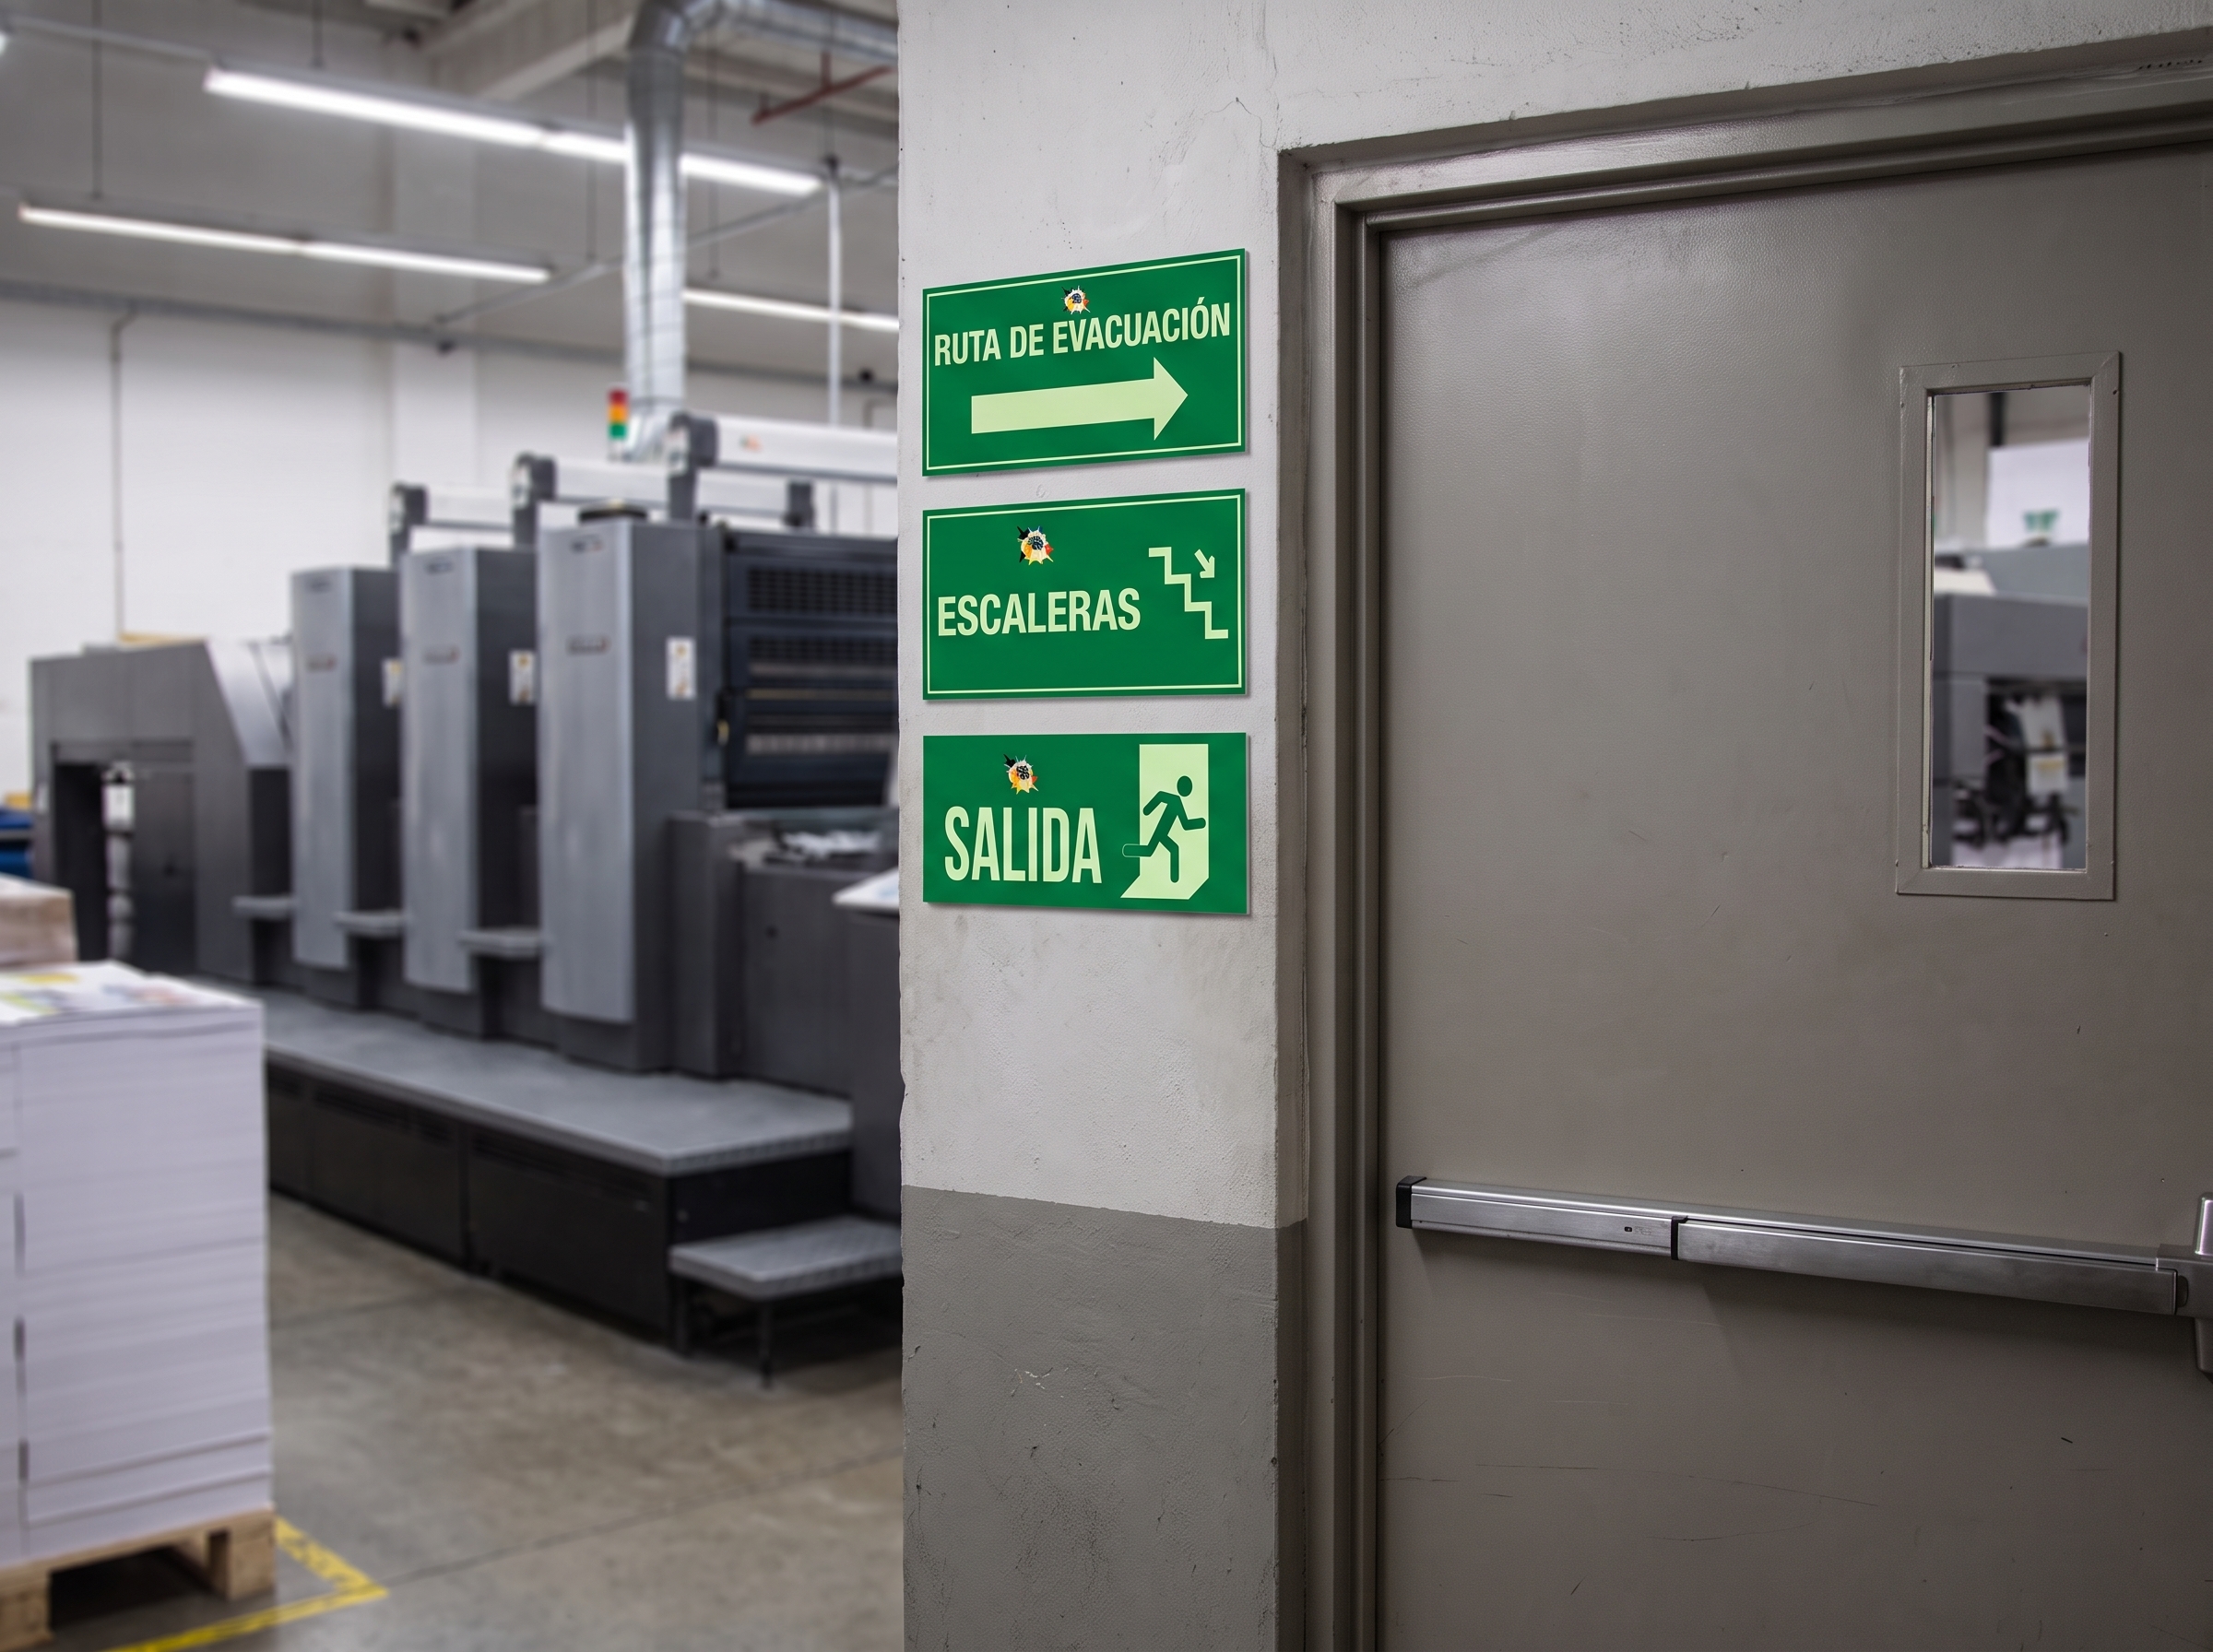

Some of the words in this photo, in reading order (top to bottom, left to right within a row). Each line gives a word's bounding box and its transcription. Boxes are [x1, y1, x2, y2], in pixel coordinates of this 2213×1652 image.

[934, 328, 1001, 366] RUTA
[1010, 324, 1044, 359] DE
[1053, 297, 1230, 354] EVACUACIÓN
[938, 587, 1141, 636] ESCALERAS
[944, 806, 1102, 883] SALIDA
